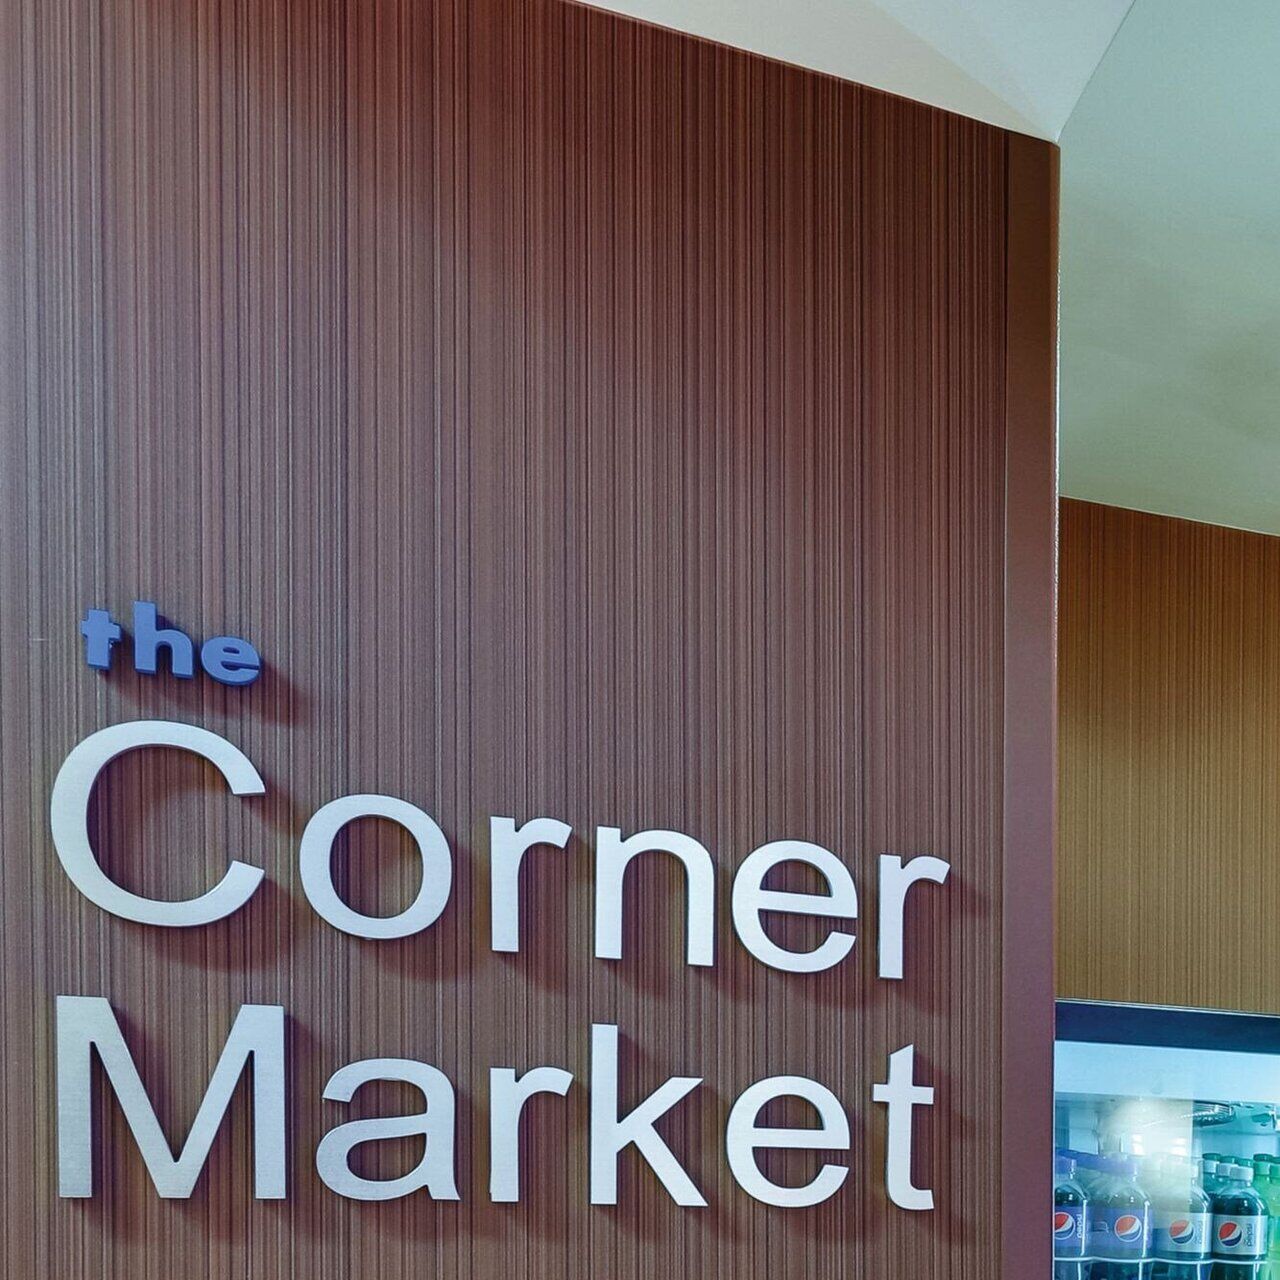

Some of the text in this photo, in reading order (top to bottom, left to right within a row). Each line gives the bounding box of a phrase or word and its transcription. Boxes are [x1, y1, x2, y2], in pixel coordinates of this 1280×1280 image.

[80, 601, 262, 687] the
[50, 719, 951, 981] Corner
[56, 994, 936, 1211] Market
